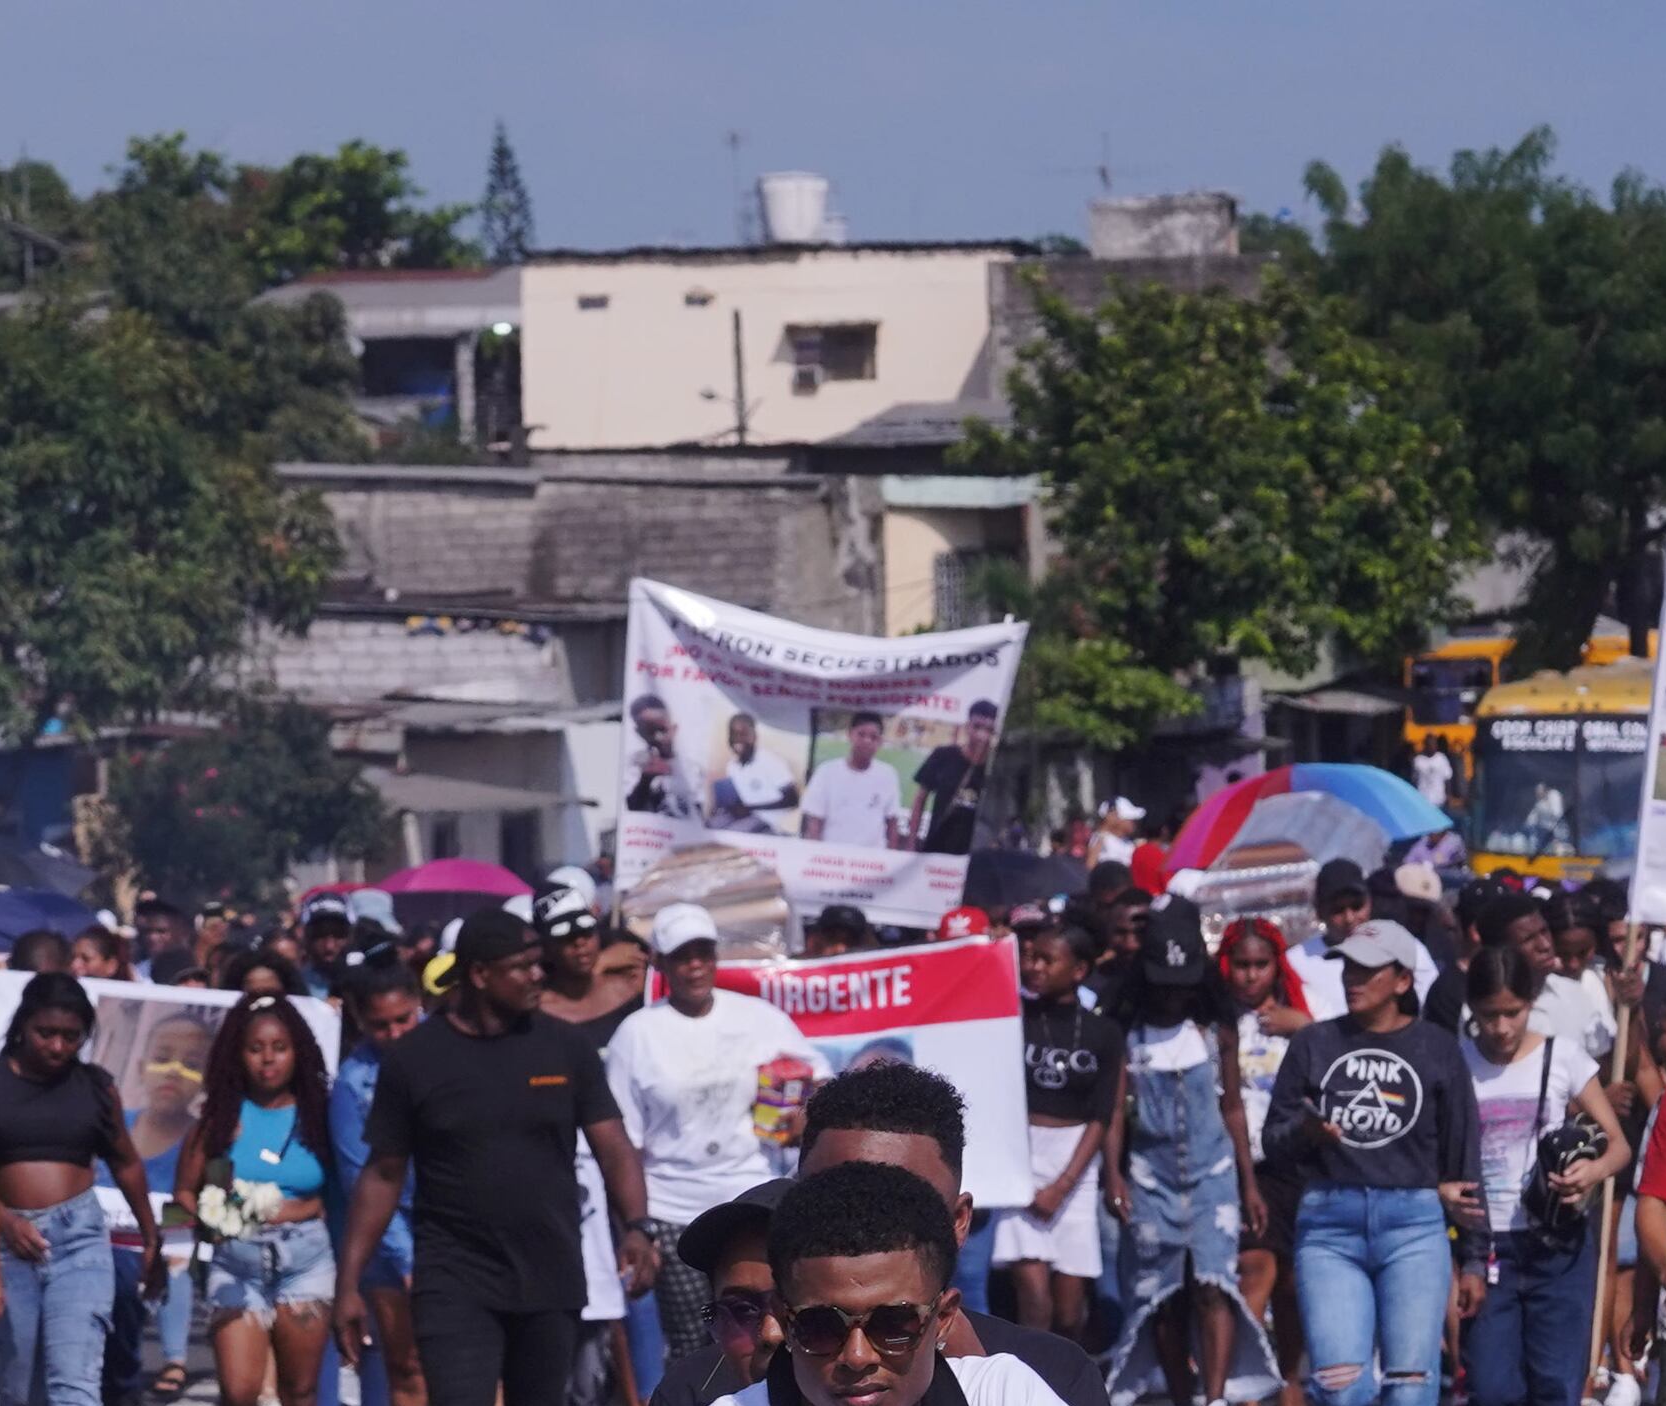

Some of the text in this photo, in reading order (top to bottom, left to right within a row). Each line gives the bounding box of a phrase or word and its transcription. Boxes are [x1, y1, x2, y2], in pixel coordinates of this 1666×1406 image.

[758, 964, 913, 1015] URGENTE
[1345, 1056, 1403, 1084] PINK
[1330, 1105, 1402, 1134] FLOYD
